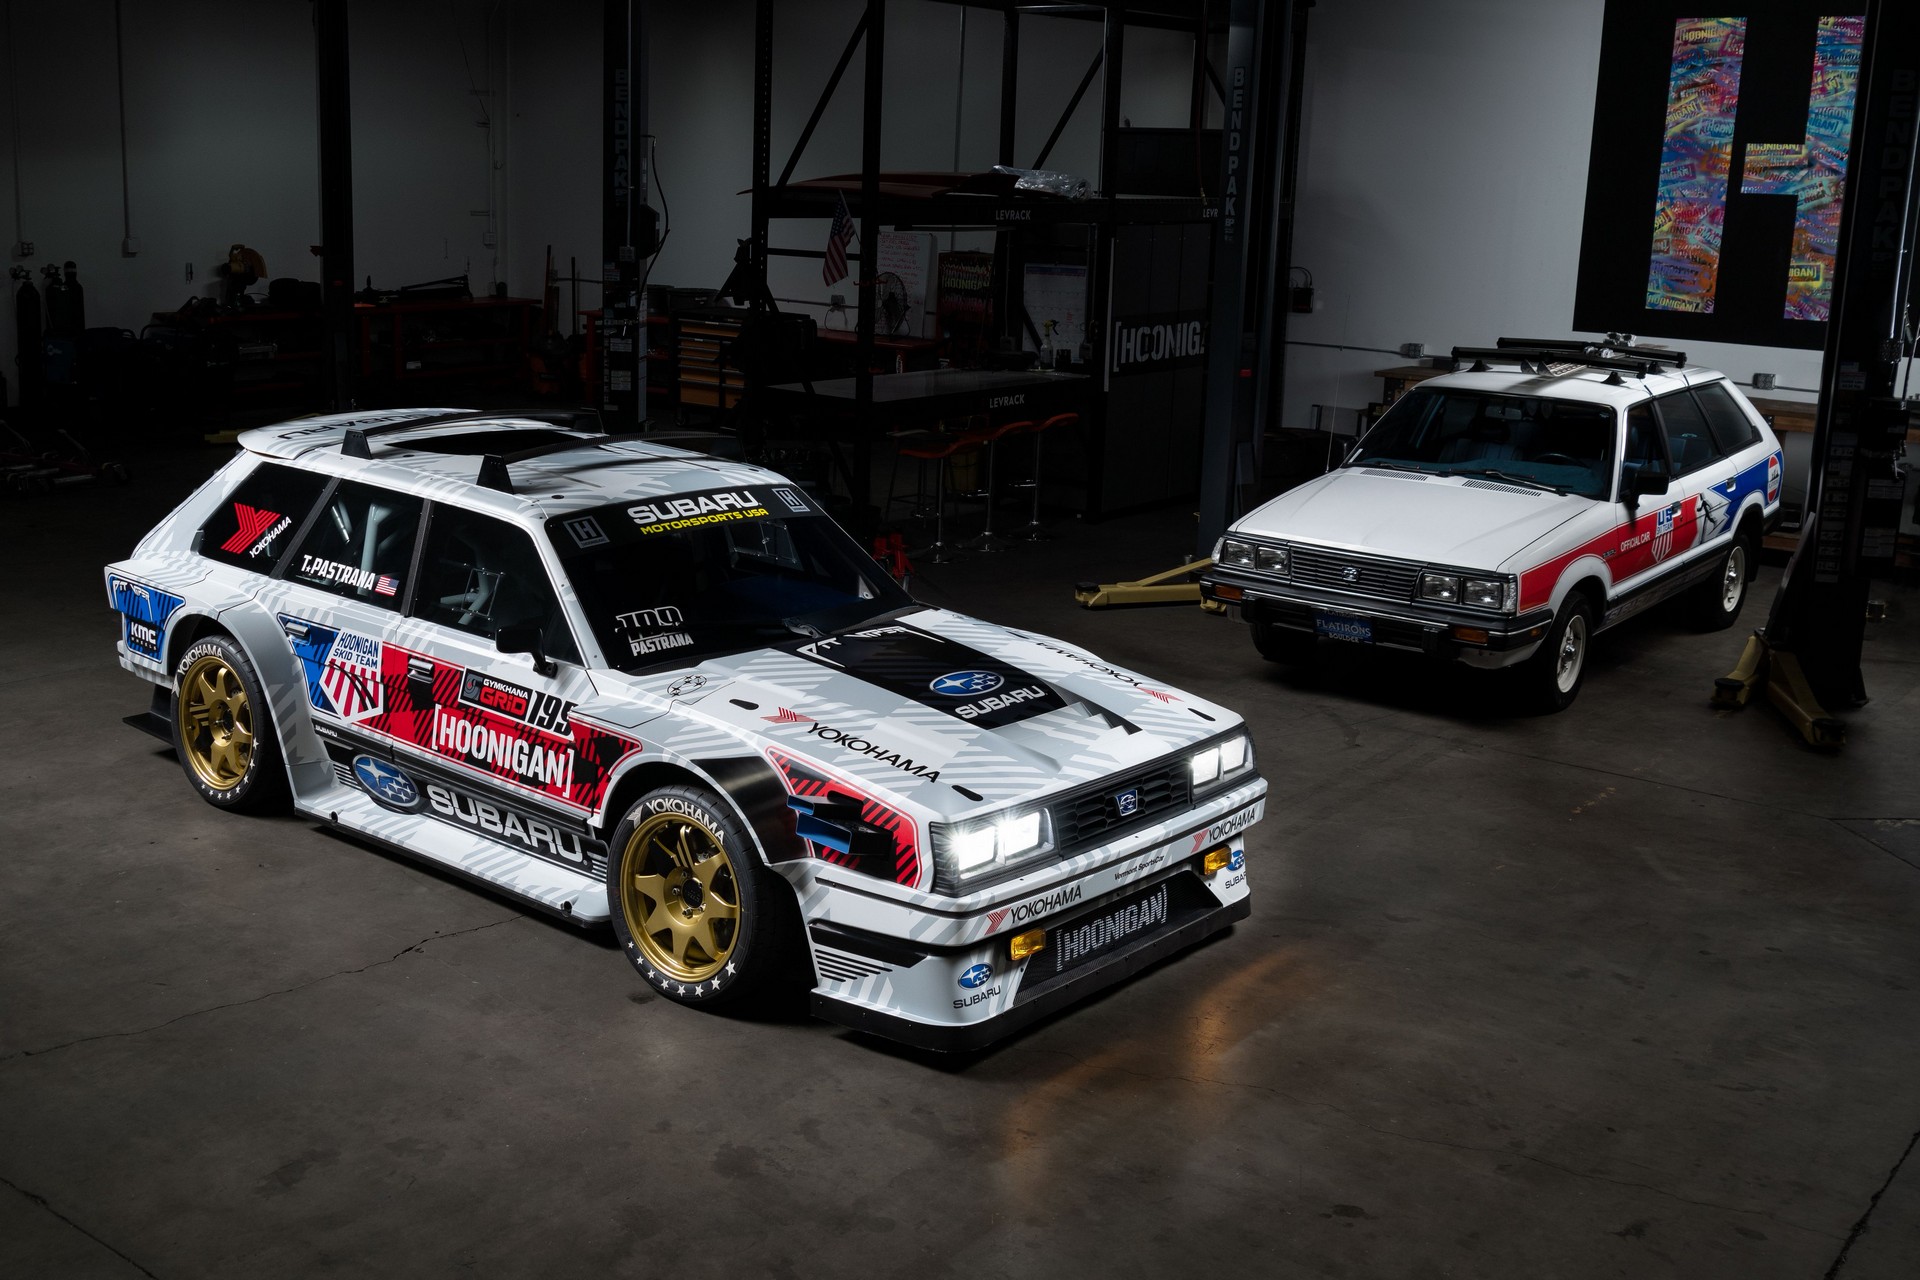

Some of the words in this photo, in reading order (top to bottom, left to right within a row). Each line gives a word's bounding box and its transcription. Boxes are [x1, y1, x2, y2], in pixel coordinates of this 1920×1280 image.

[1225, 67, 1245, 216] BENDPAK
[1871, 69, 1916, 248] BENDPAK
[995, 210, 1031, 221] LEVRACK
[1113, 320, 1205, 372] [HOONIG
[989, 394, 1025, 408] LEVRACK
[627, 491, 758, 525] SUBARU
[1657, 508, 1673, 526] US
[640, 511, 743, 535] MOTORSPORTS
[744, 508, 769, 518] USA
[249, 516, 292, 559] YOKOHAMA
[1621, 535, 1640, 552] OFFICIAL
[1640, 531, 1650, 544] CAR
[131, 621, 156, 645] KMC
[1316, 619, 1372, 637] FLATIRONS
[1328, 632, 1360, 643] BOULDER
[337, 632, 380, 658] HOONIGAN
[630, 632, 694, 657] PASTRANA
[177, 644, 224, 675] YOKOHAMA
[333, 648, 353, 661] SKID
[355, 654, 378, 669] TEAM
[1036, 642, 1142, 688] YOKOHAMA
[483, 678, 529, 699] GYMKHANA
[954, 686, 1045, 720] SUBARU
[315, 724, 338, 738] SUBARU
[807, 722, 941, 783] YOKOHAMA
[426, 785, 585, 863] SUBARU
[646, 798, 725, 845] YOKOHAMA
[1209, 806, 1256, 843] YOKOHAMA
[1114, 867, 1138, 881] Vermont
[1011, 884, 1082, 924] YOKOHAMA
[953, 985, 1001, 1009] SUBARU
